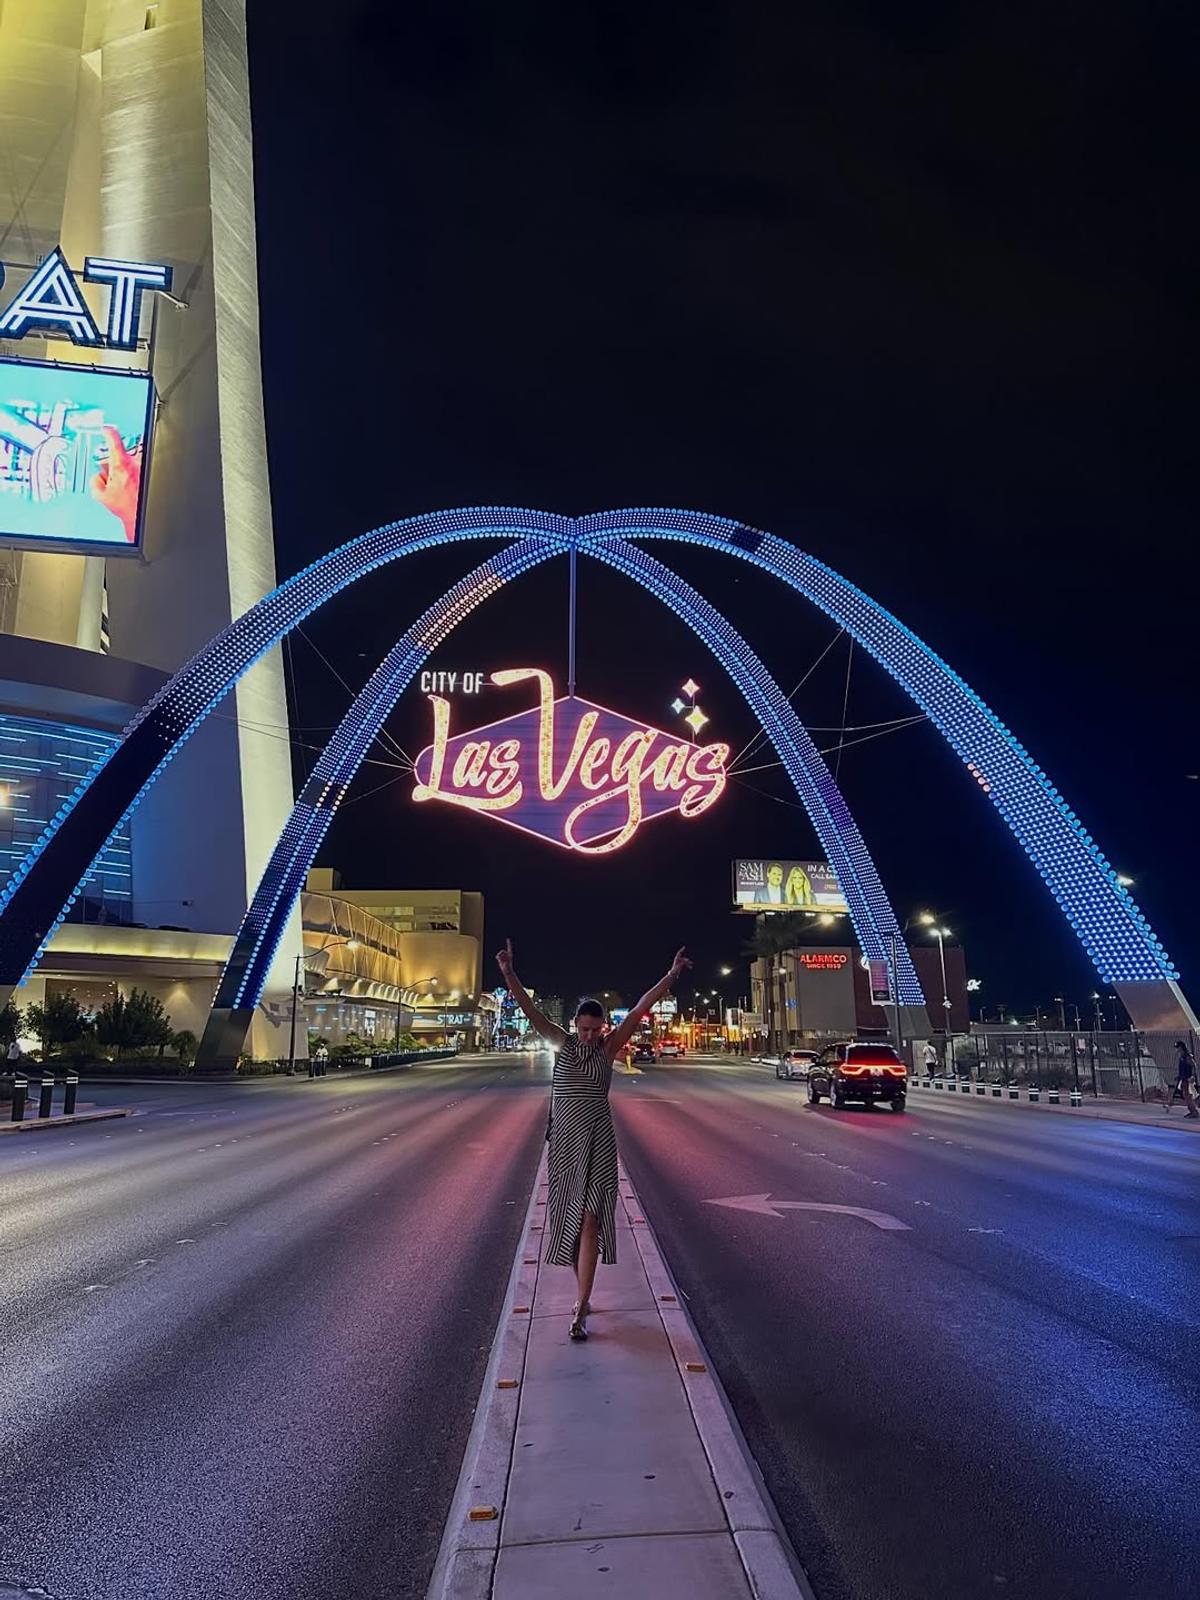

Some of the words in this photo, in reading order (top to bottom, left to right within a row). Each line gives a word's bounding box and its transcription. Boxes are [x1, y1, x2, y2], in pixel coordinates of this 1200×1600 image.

[0, 245, 173, 352] AT
[421, 671, 456, 694] CITY
[463, 672, 484, 694] OF
[412, 694, 522, 810] Las
[490, 668, 730, 854] Vegas
[740, 862, 764, 872] SAM
[807, 864, 817, 872] IN
[741, 871, 764, 881] ASH
[800, 954, 847, 963] ALARMCO
